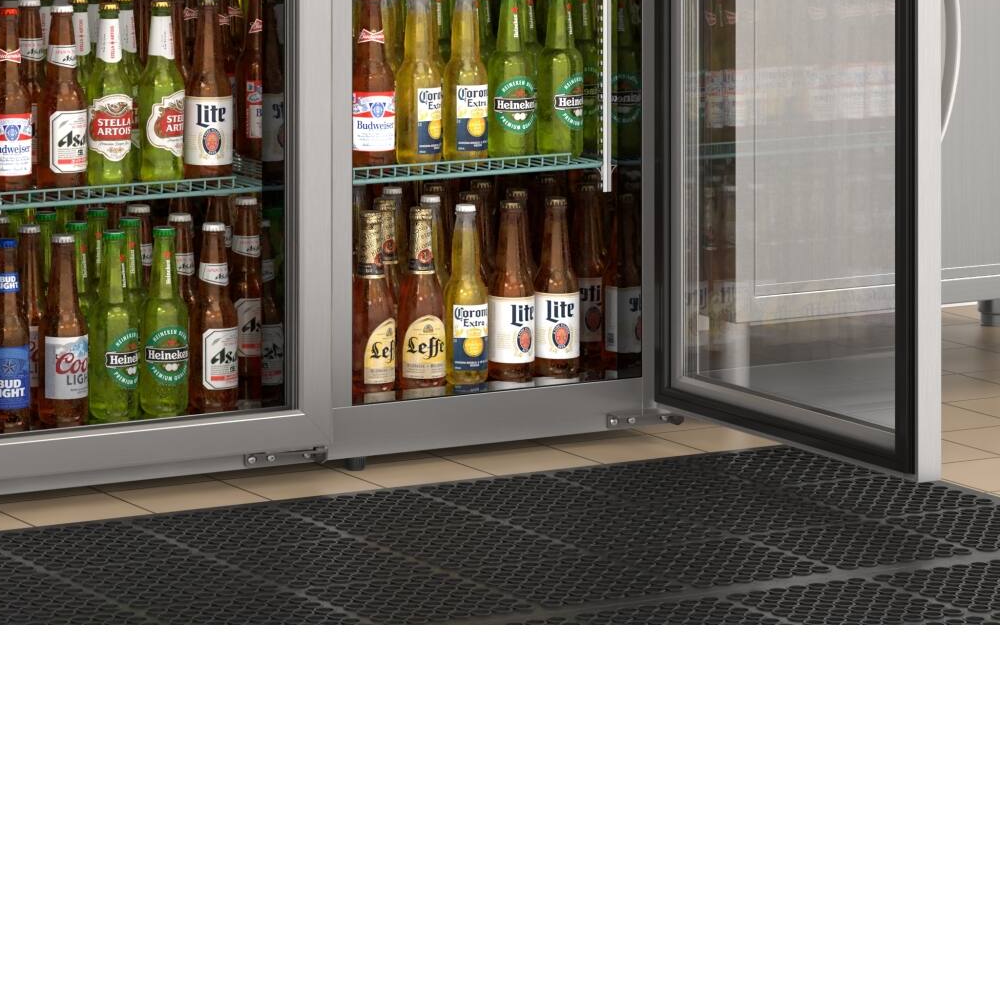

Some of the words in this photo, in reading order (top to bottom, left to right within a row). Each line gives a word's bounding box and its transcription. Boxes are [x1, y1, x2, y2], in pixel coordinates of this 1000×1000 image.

[97, 117, 131, 127] STELLA
[196, 104, 226, 127] Lite
[97, 126, 131, 136] ARTOIS
[357, 120, 394, 131] Budweiser
[546, 300, 575, 323] Lite
[407, 336, 445, 360] Leffe
